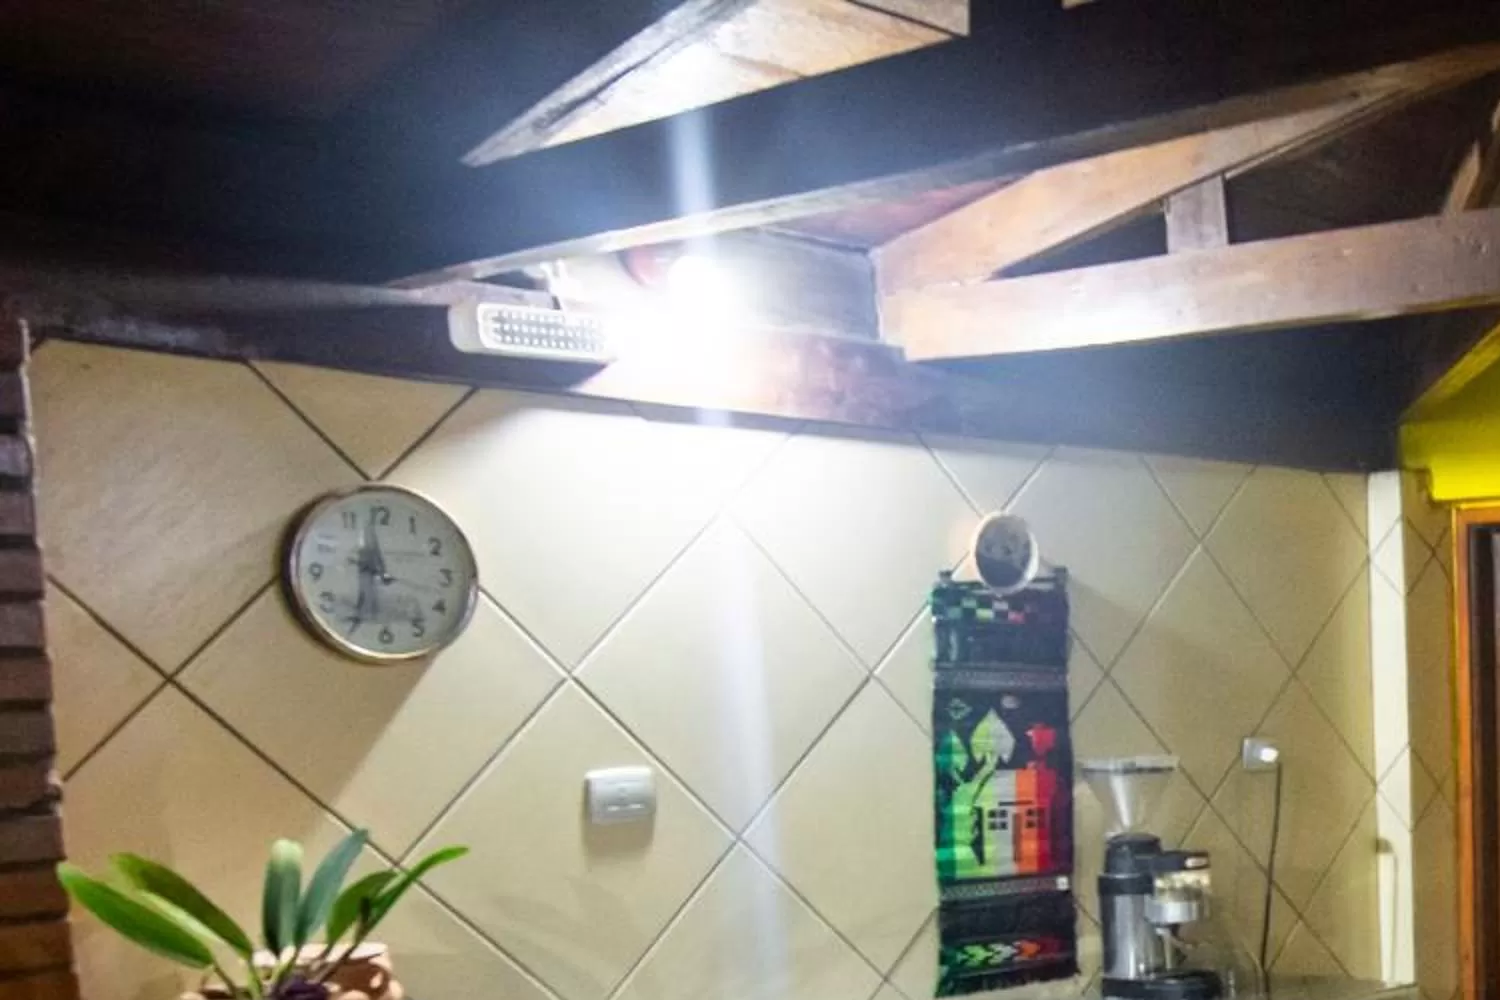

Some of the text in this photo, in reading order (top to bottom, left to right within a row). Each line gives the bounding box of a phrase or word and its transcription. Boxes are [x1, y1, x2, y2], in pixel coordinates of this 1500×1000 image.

[342, 511, 357, 530] 11
[370, 505, 391, 527] 12
[408, 515, 417, 535] 1
[428, 536, 442, 557] 2
[308, 561, 324, 581] 9
[439, 567, 453, 588] 3
[431, 599, 447, 615] 4
[378, 625, 395, 645] 6
[411, 616, 426, 638] 5
